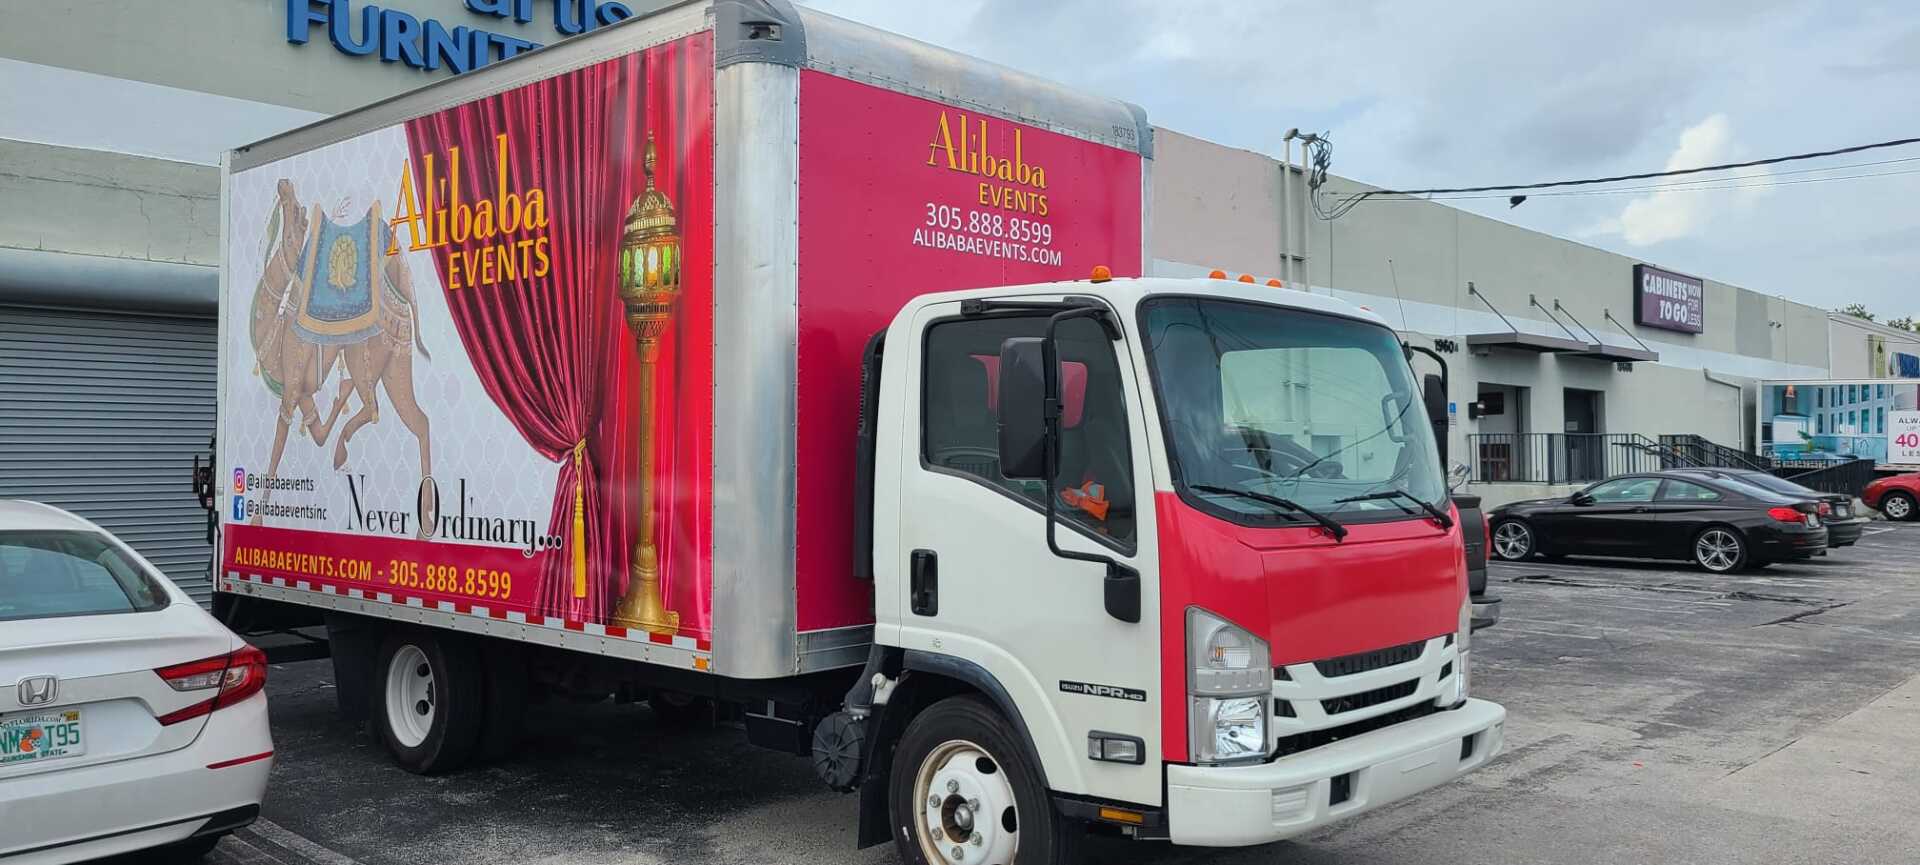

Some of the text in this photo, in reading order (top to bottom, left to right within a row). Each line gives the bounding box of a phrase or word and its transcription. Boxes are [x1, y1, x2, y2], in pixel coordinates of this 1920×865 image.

[287, 0, 544, 74] FURNIT
[927, 110, 1048, 189] Alibaba
[386, 133, 549, 257] Alibaba
[979, 182, 1049, 217] EVENTS
[926, 203, 1052, 245] 305.888.8599
[448, 236, 550, 290] EVENTS
[913, 228, 1062, 266] ALIBABAEVENTS.COM
[1643, 273, 1687, 301] CABINETS
[1898, 416, 1920, 424] ALW
[1895, 433, 1919, 448] 40
[246, 473, 314, 492] @alibabaevents
[246, 499, 327, 520] @alibabaeventsinc
[346, 474, 562, 558] Never Ordinary...
[235, 546, 372, 581] ALIBABAEVENTS.COM
[389, 559, 512, 600] 305.888.8599
